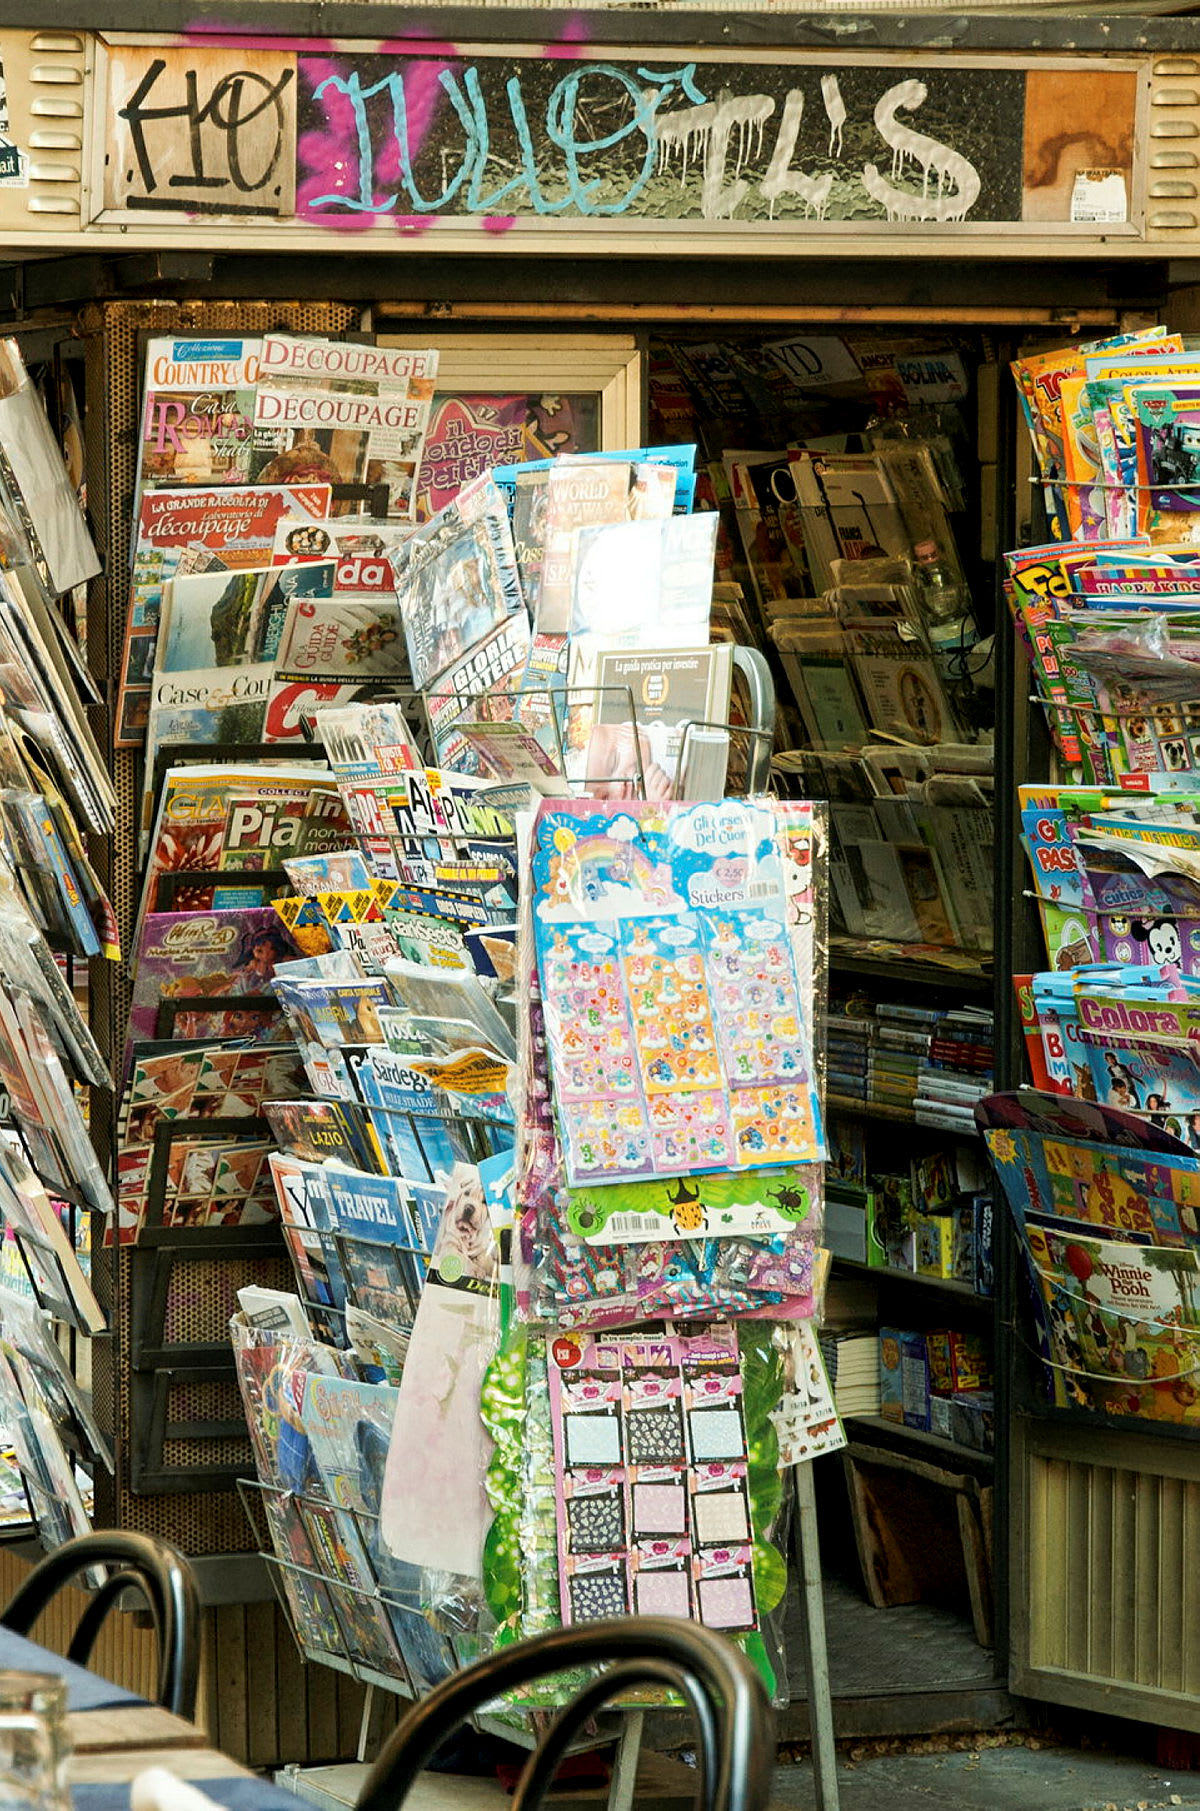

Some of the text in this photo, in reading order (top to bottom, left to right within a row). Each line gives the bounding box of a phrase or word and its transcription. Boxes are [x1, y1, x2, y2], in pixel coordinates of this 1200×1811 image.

[264, 340, 427, 378] DÉCOUPAGE
[191, 394, 236, 415] Casa
[447, 420, 463, 439] il
[422, 428, 523, 463] ondo di
[167, 499, 207, 512] GRANDE
[148, 513, 251, 542] découpage
[1096, 583, 1155, 595] HAPPY
[615, 660, 622, 672] La
[623, 659, 640, 675] guida
[641, 658, 661, 674] pratica
[661, 660, 673, 673] per
[158, 682, 208, 706] Case
[228, 803, 302, 848] Pia
[694, 816, 708, 831] Gli
[695, 830, 716, 847] Del
[691, 888, 745, 906] Stickers
[1079, 998, 1182, 1035] Colora
[310, 1131, 343, 1147] LAZIO
[334, 1191, 398, 1227] TRAVEL
[1100, 1262, 1152, 1282] Winnie
[1110, 1277, 1150, 1297] Pooh
